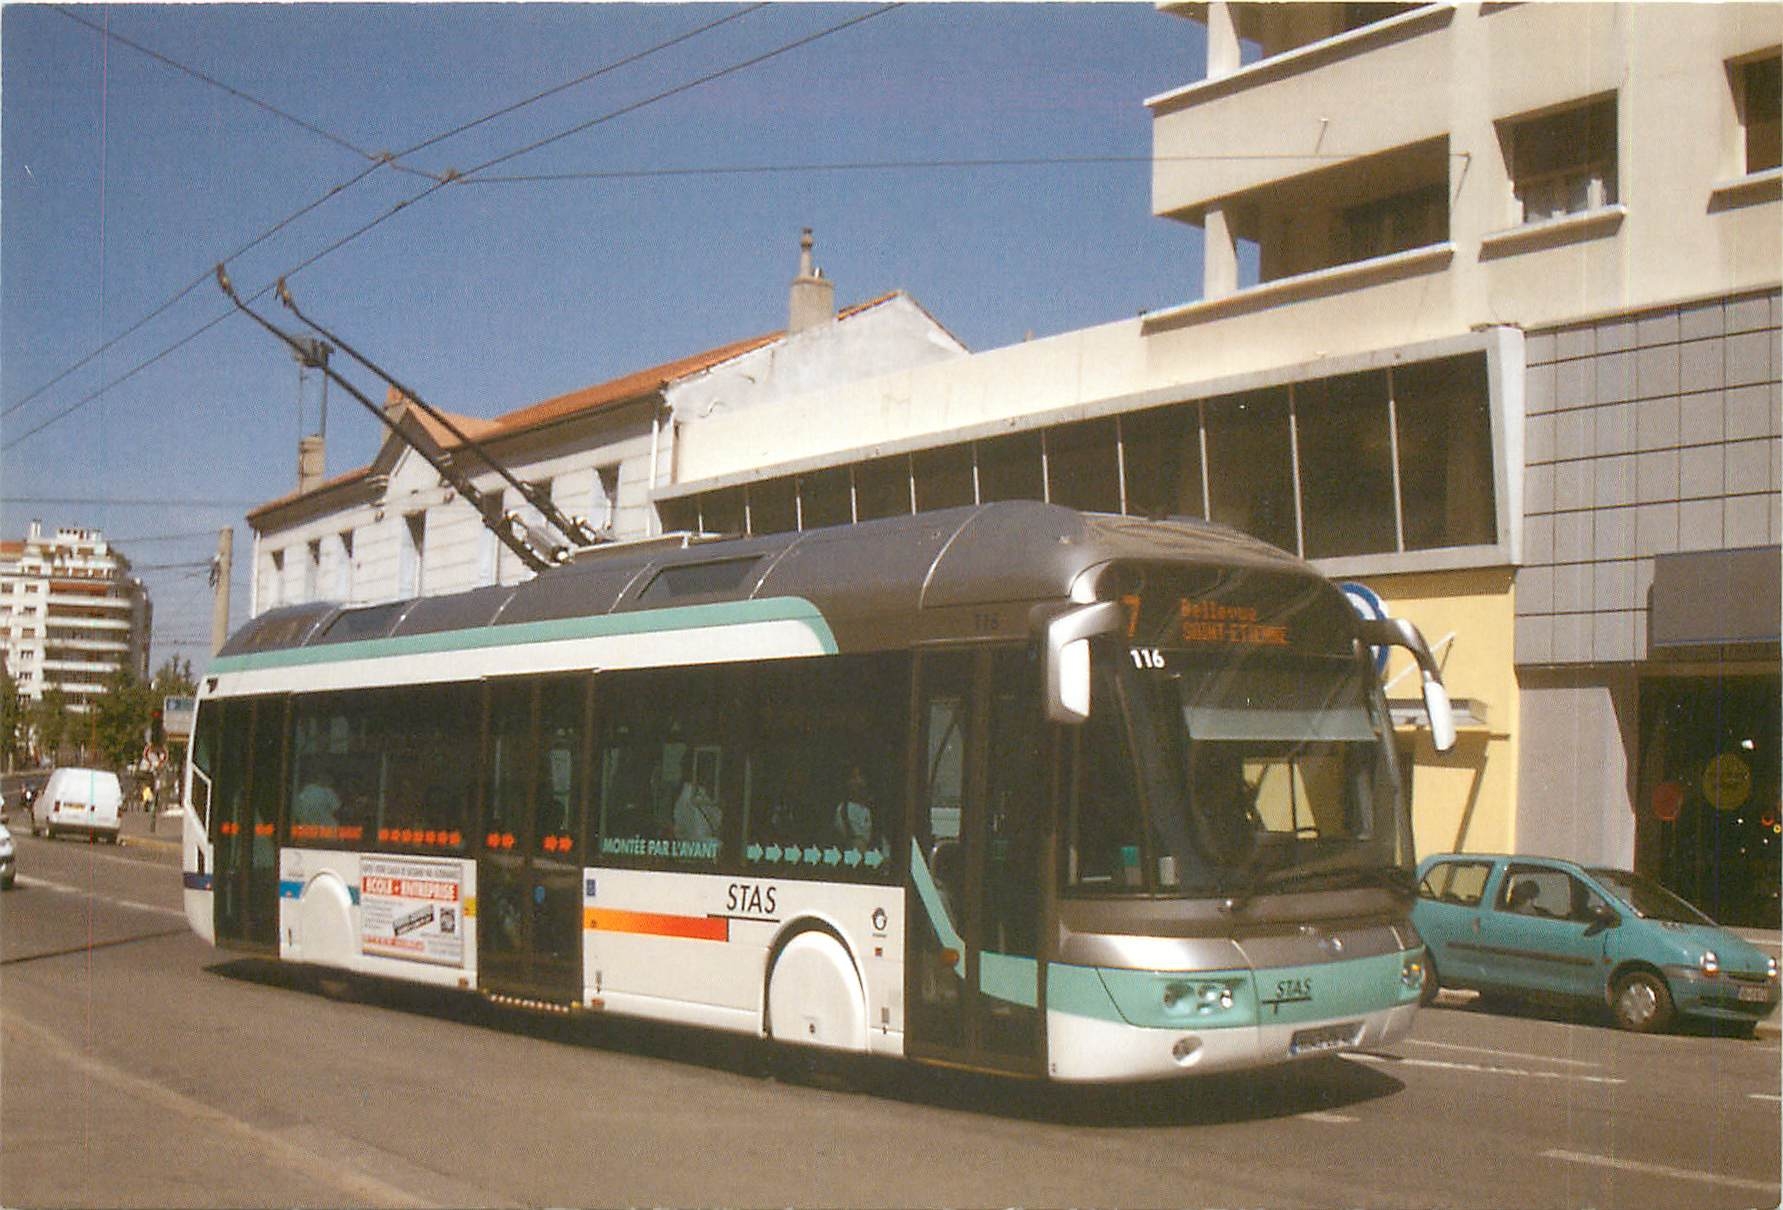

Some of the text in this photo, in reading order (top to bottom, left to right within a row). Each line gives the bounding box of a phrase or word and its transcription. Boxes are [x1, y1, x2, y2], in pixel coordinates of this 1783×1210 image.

[1120, 594, 1141, 639] 7
[1130, 649, 1166, 669] 116
[602, 834, 718, 858] MONTÉE PAR L'AVANT
[726, 883, 776, 914] STAS
[1276, 978, 1311, 998] STAS
